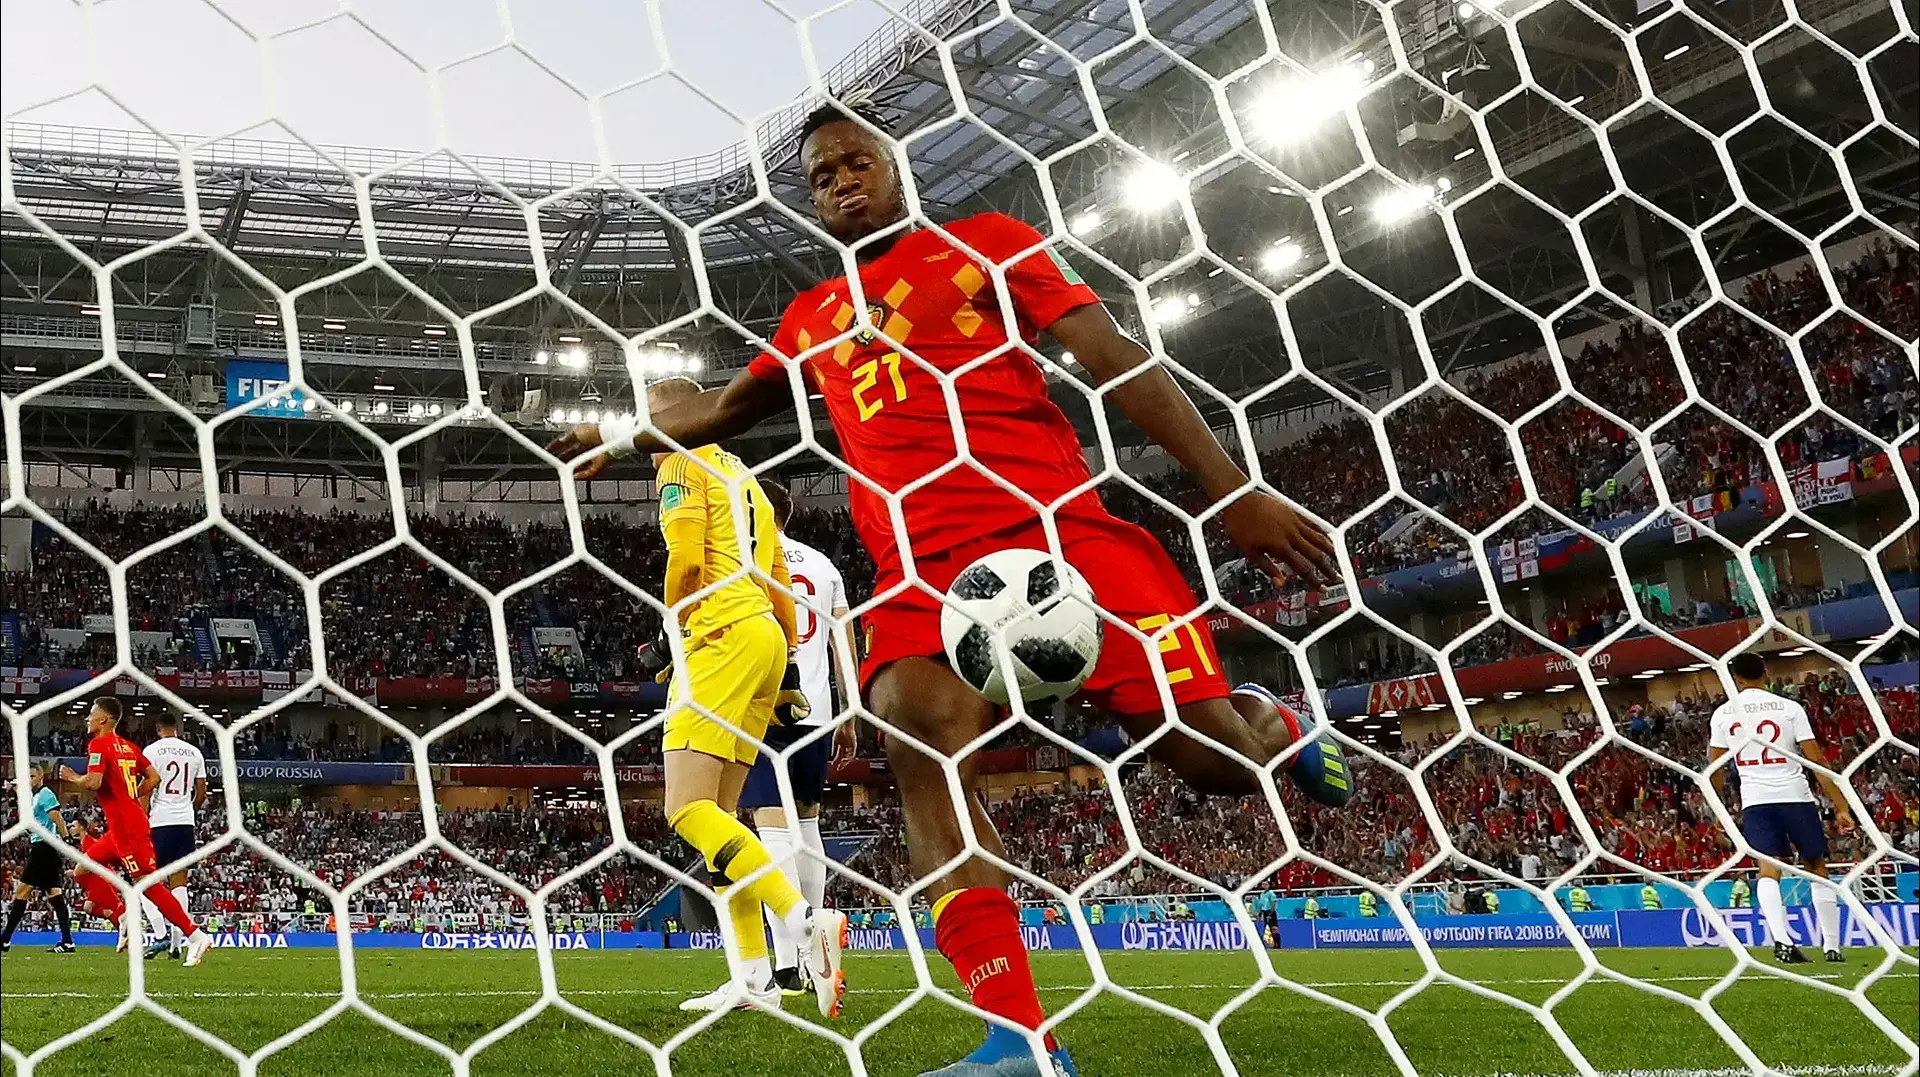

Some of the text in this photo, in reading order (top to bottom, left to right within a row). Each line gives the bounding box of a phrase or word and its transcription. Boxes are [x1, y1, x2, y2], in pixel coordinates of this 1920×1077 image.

[238, 378, 292, 399] FIFA
[852, 351, 907, 422] 21
[1136, 613, 1215, 684] 21
[570, 682, 599, 693] LIPSIA
[1729, 719, 1787, 767] 22
[165, 760, 189, 796] 21
[246, 766, 273, 778] CUP
[276, 767, 323, 778] RUSSIA
[450, 933, 498, 948] 万达
[1143, 923, 1182, 950] 万达
[1318, 928, 1379, 943] ЧЕМПИОНАТ
[1433, 926, 1485, 941] ФУТБОЛУ
[1487, 926, 1513, 941] FIFA
[1515, 925, 1543, 940] 2018
[1545, 925, 1555, 939] В
